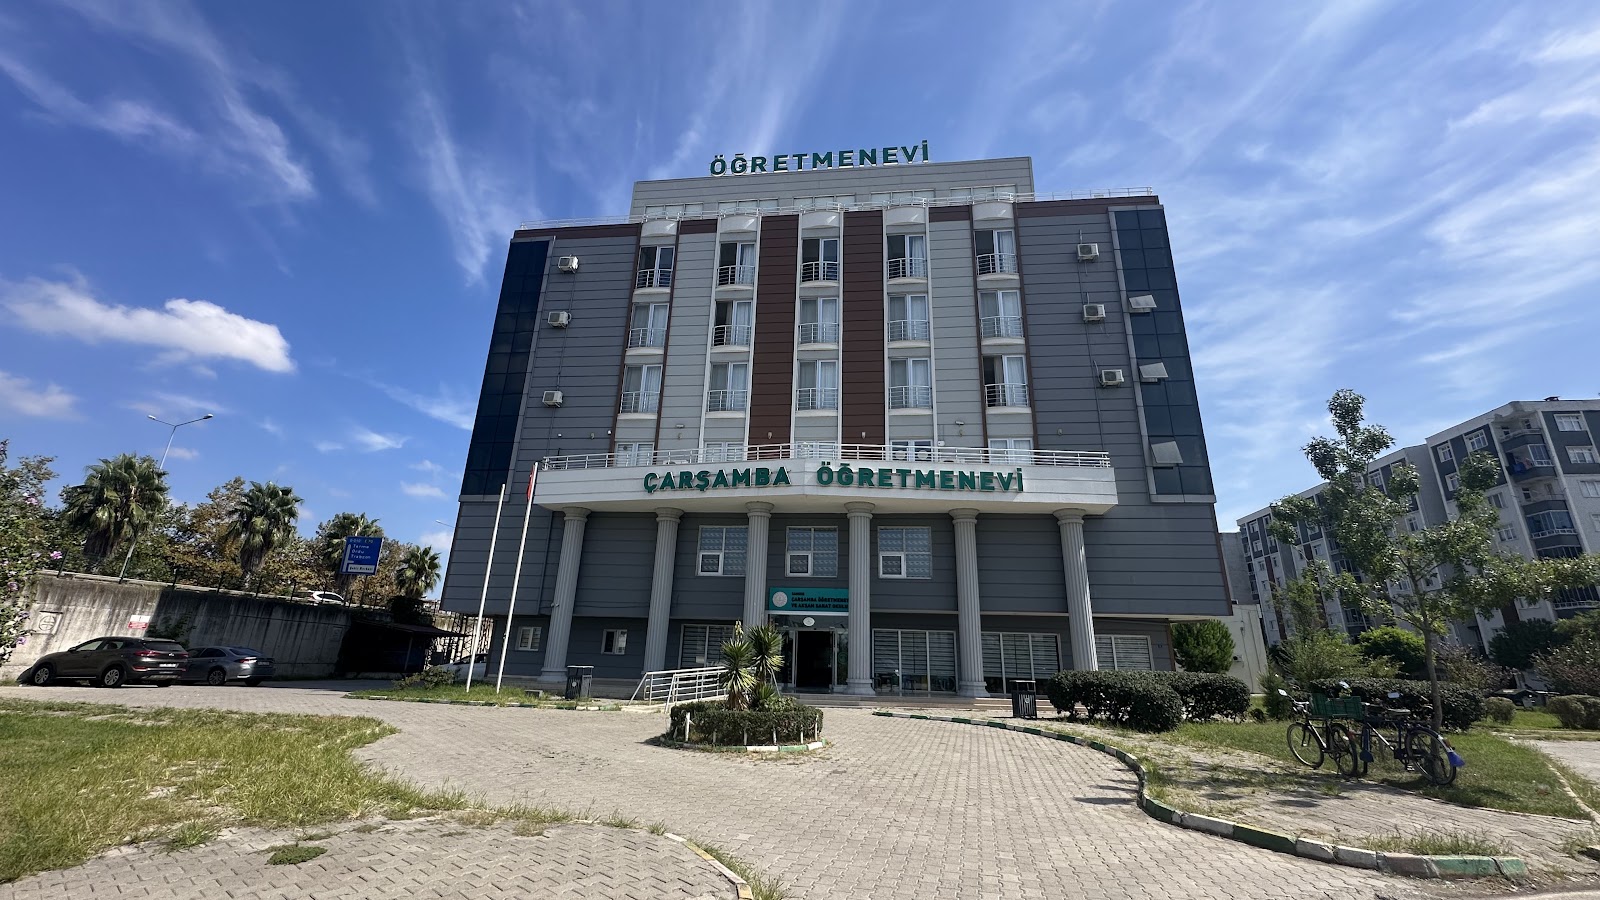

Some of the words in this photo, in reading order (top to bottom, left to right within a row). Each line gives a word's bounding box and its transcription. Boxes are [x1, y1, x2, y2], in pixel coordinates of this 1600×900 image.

[710, 140, 928, 177] ÖĞRETMENEVİ
[643, 466, 791, 493] ÇARŞAMBA
[817, 461, 1023, 492] ÖĞRETMENEVİ
